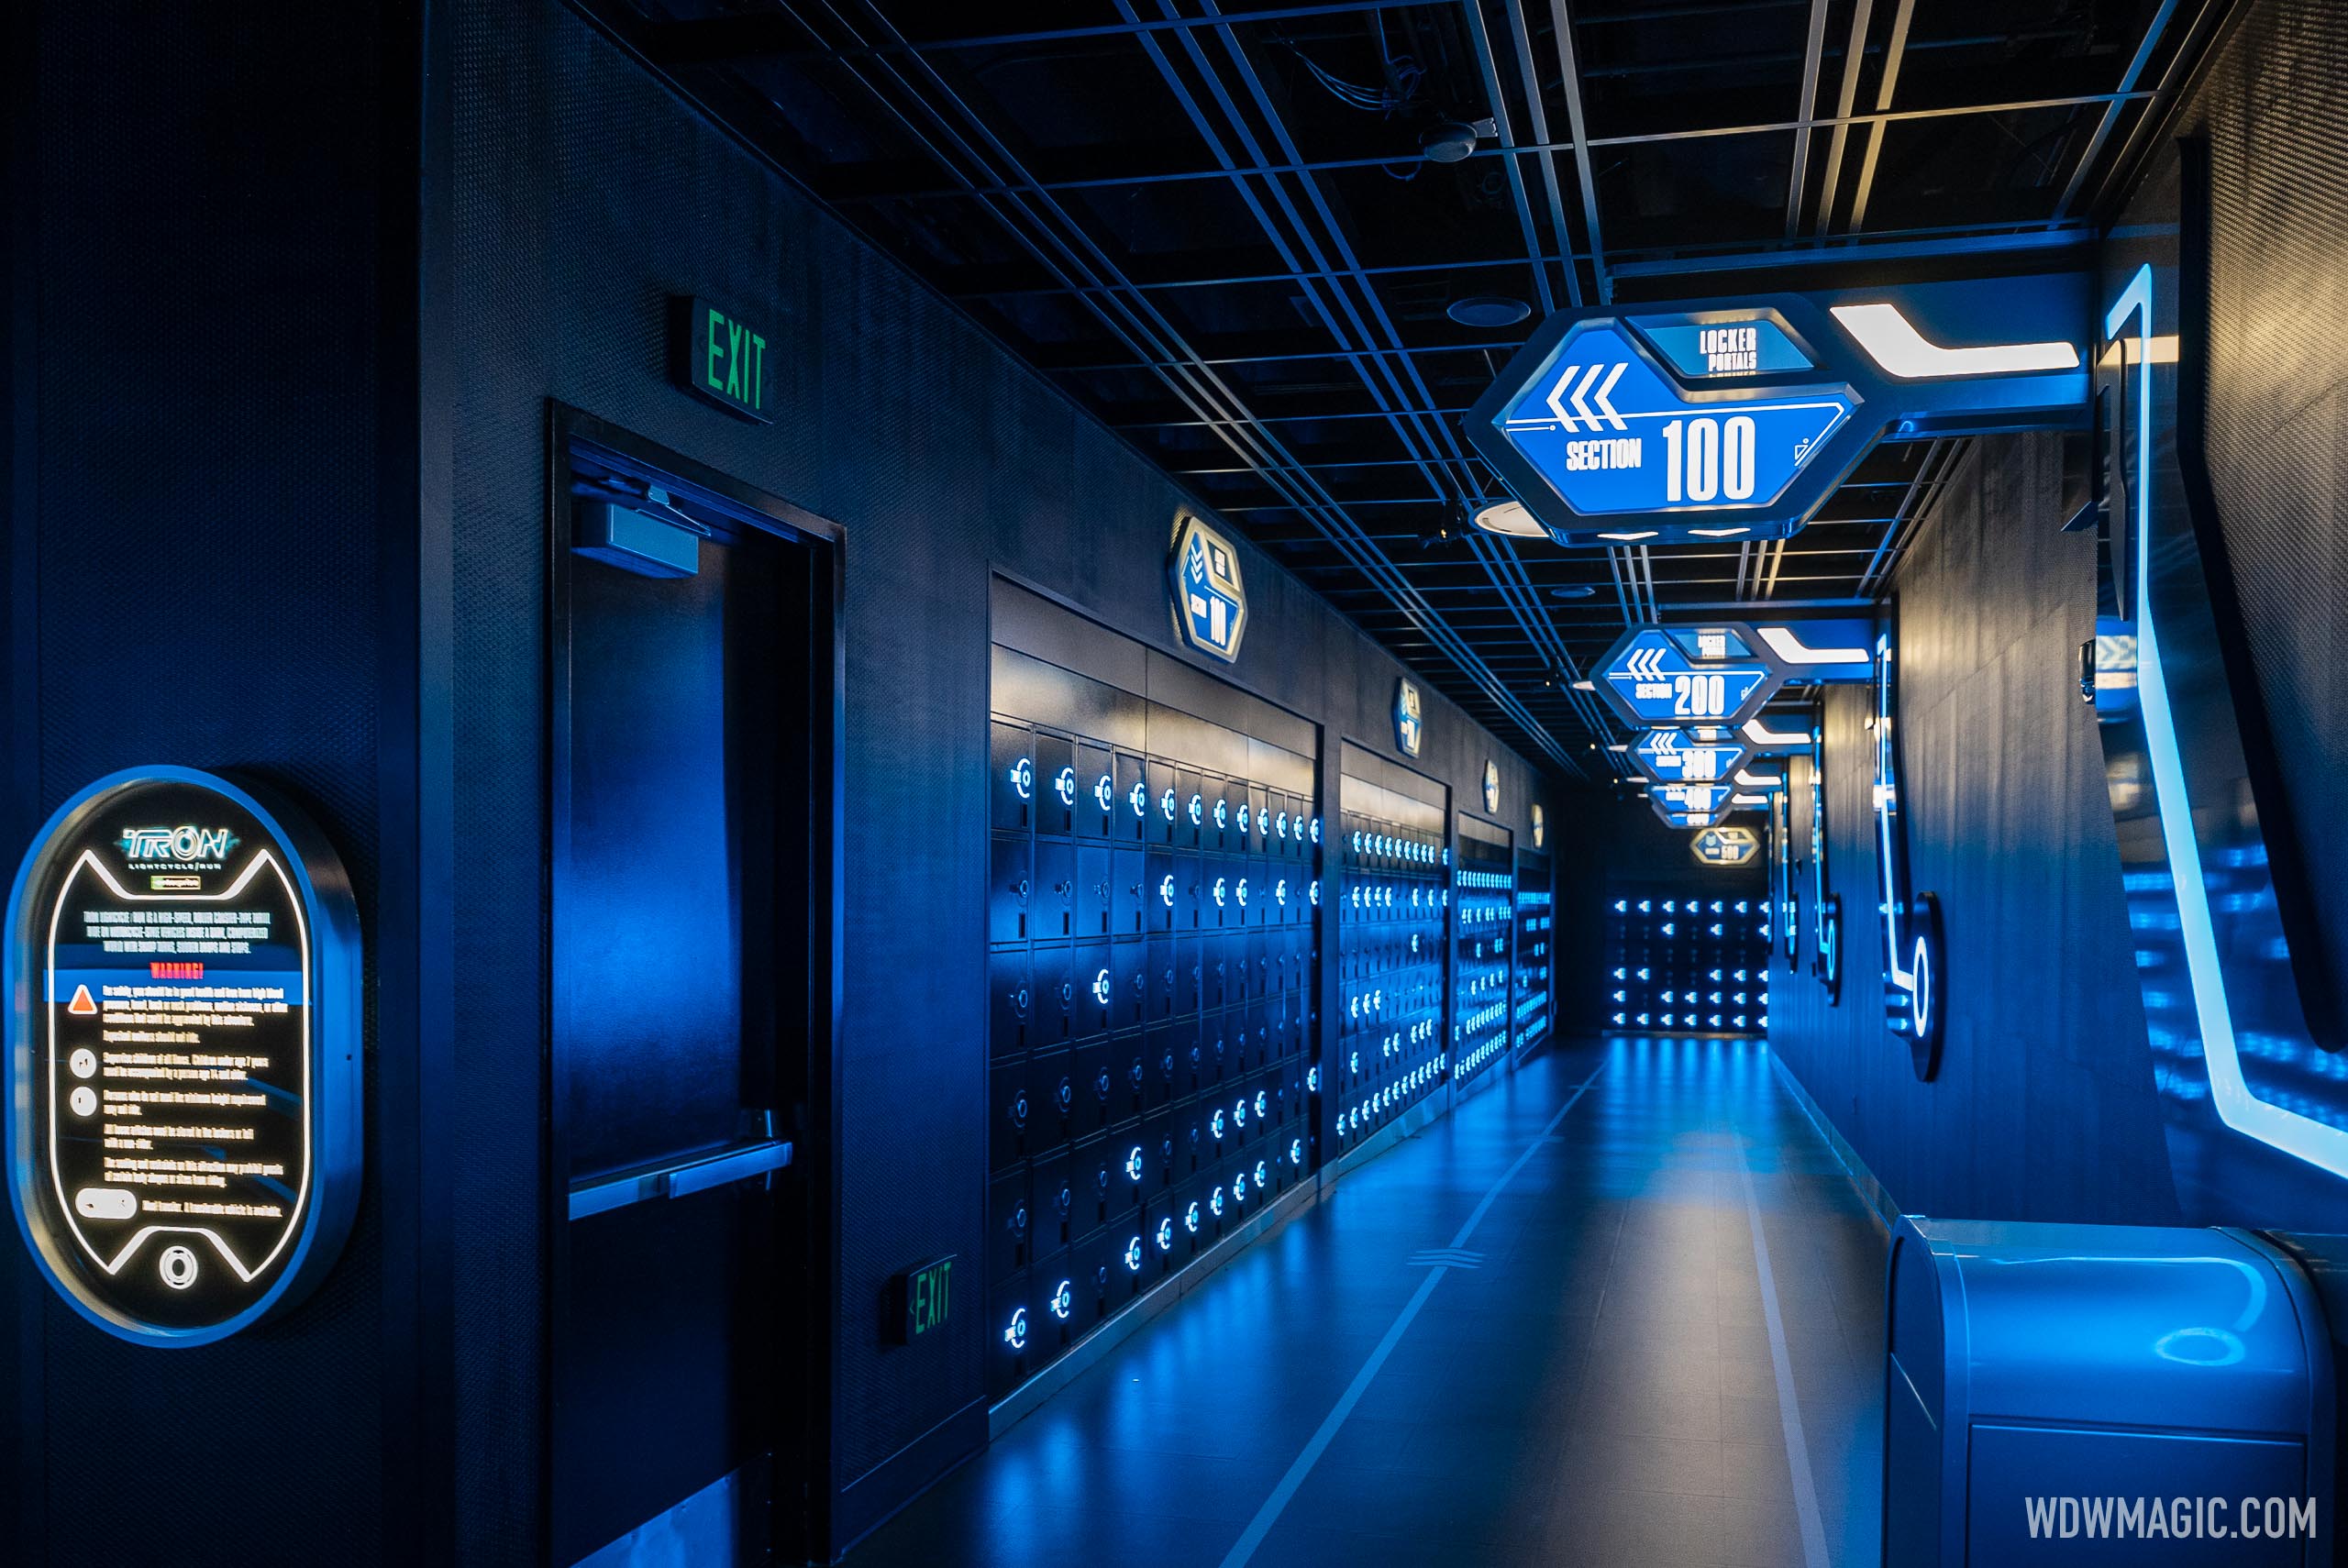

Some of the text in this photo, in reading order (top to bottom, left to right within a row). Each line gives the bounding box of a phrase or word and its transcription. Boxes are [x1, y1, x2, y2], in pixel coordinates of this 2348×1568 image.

[708, 308, 766, 410] EXIT
[1700, 327, 1756, 354] LOCKER
[1708, 351, 1756, 372] PORTALS
[1567, 415, 1755, 502] SECTION 100
[1675, 675, 1724, 715] 200
[123, 825, 228, 860] TRON
[150, 962, 205, 979] WARNING!
[915, 1261, 952, 1335] EXIT
